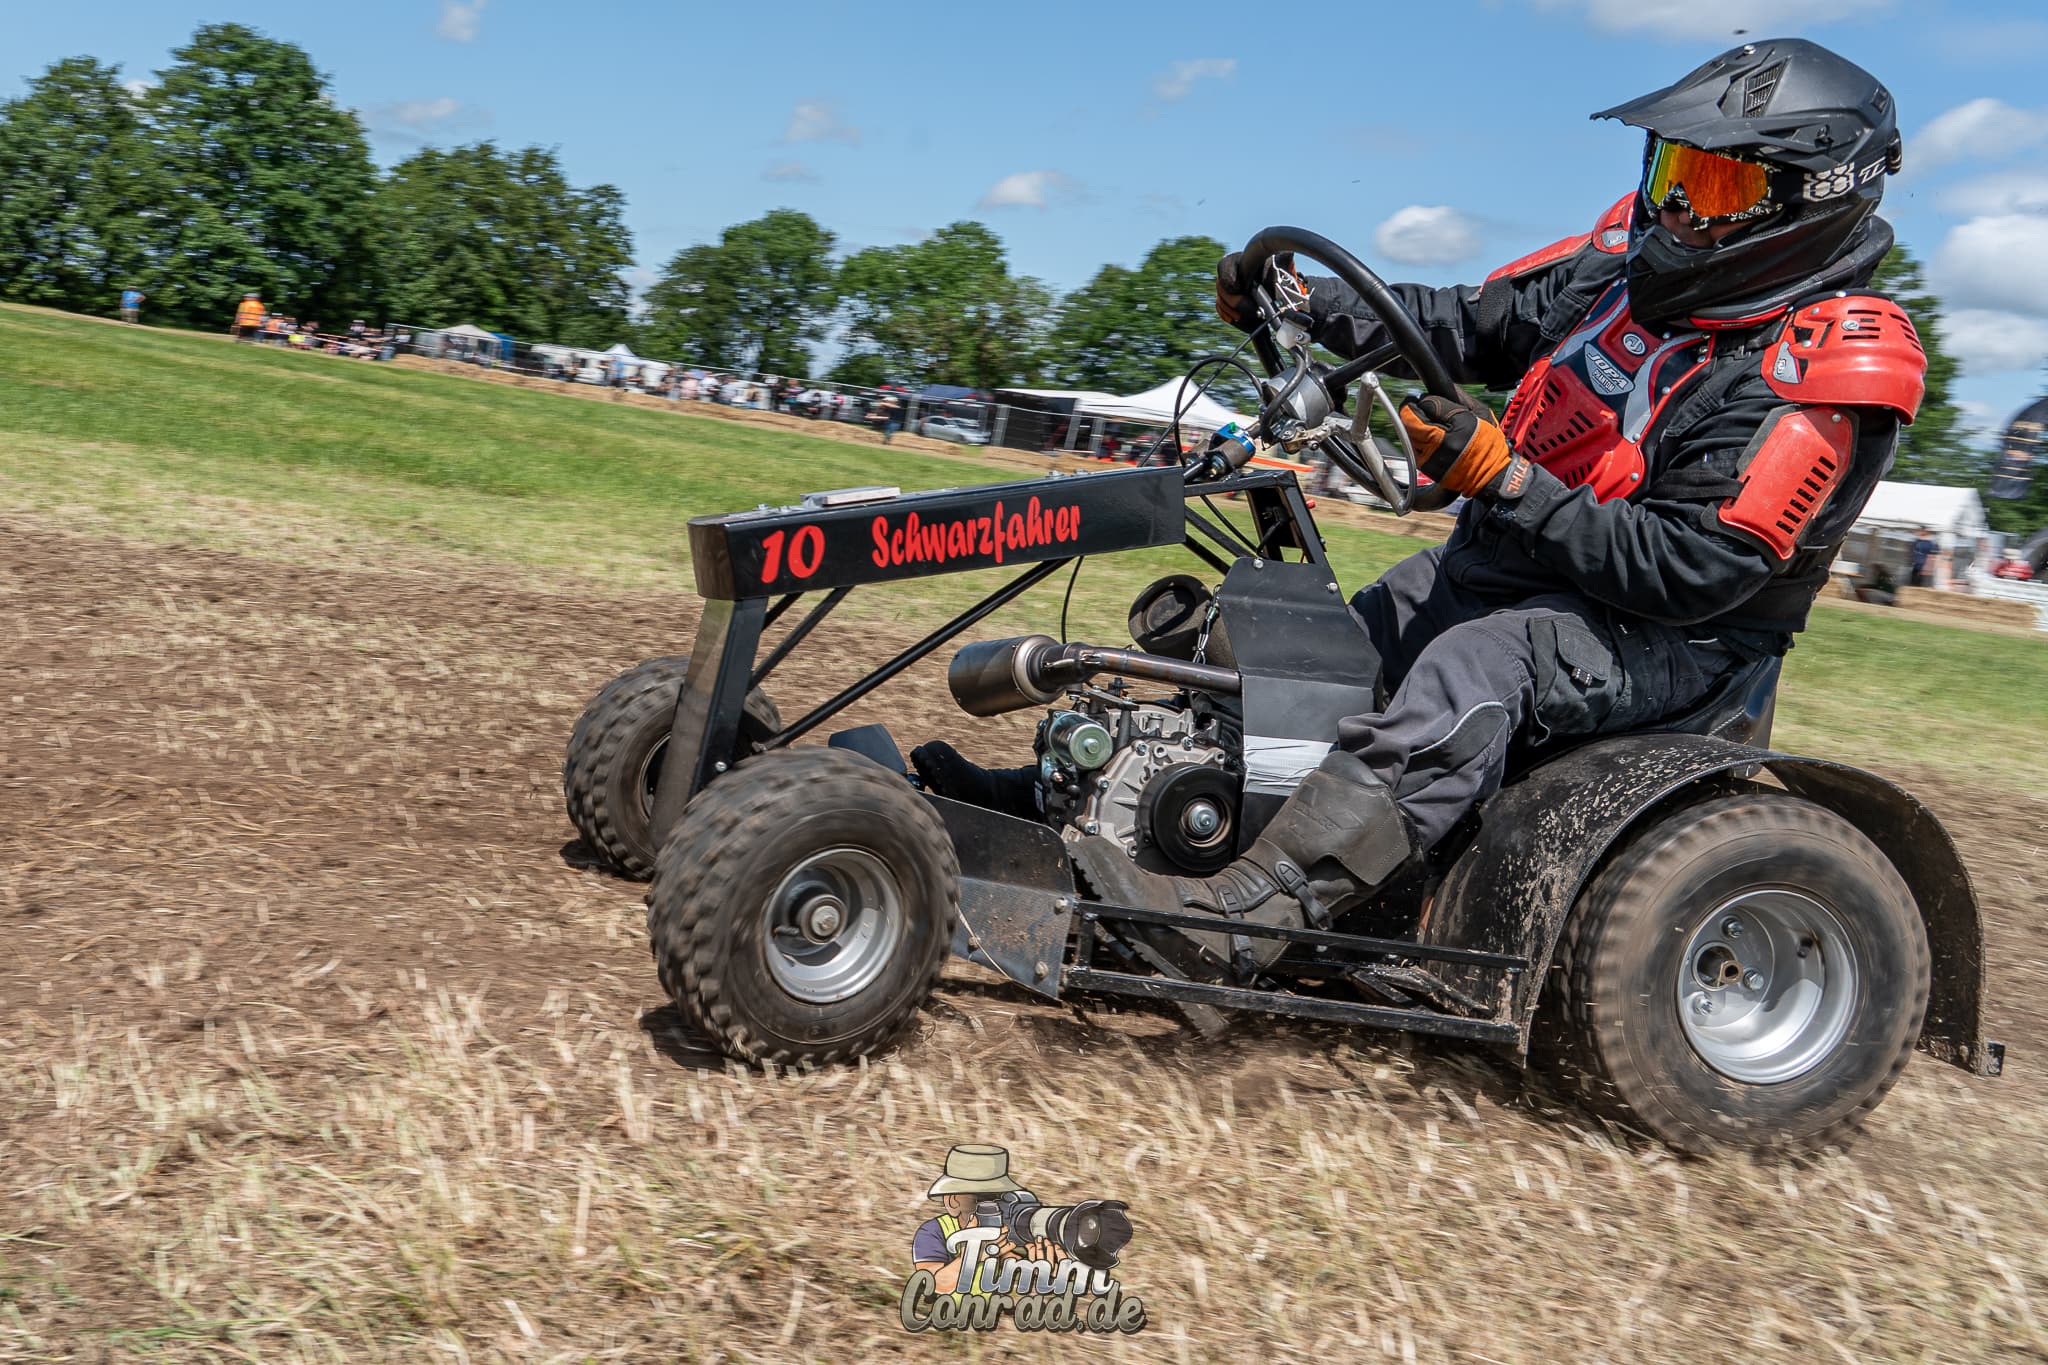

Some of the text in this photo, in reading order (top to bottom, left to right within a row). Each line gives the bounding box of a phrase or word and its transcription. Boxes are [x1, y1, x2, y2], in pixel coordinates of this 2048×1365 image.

[1586, 353, 1628, 390] JOPA
[1506, 456, 1530, 494] STIHL
[760, 496, 1081, 584] 10 Schwarzfahrer
